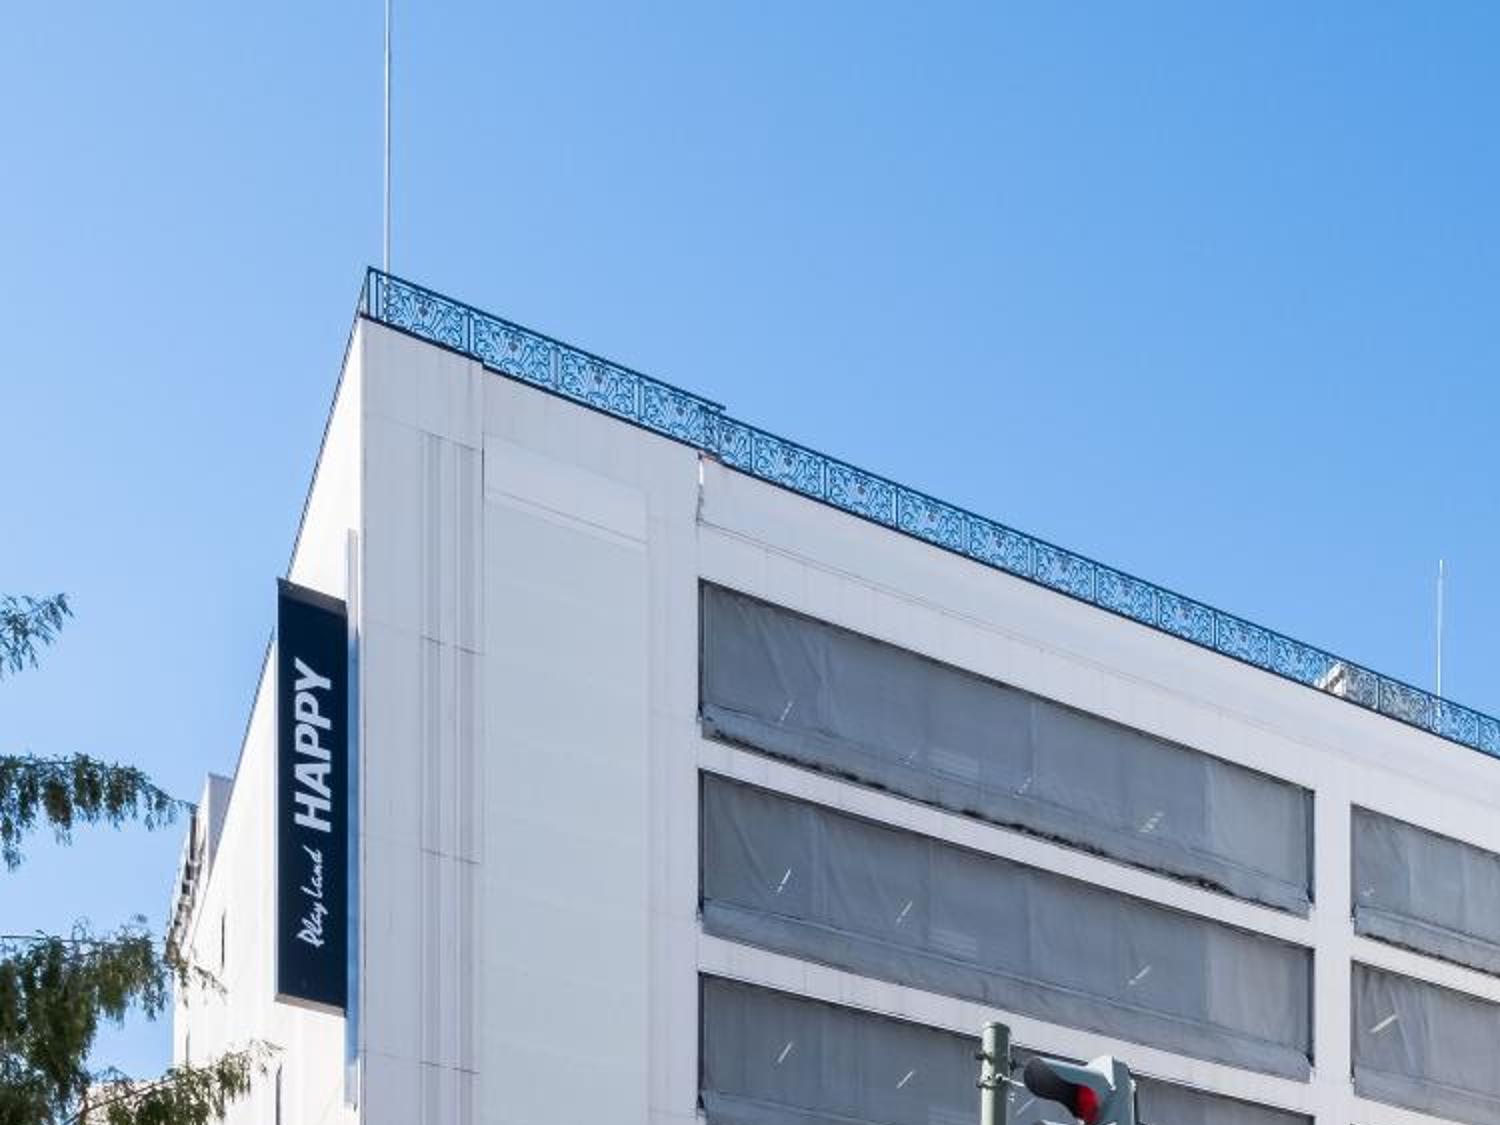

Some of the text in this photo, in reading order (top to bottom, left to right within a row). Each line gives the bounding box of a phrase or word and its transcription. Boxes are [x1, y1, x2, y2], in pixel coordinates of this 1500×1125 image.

[294, 656, 332, 948] Play Land HAPPY
